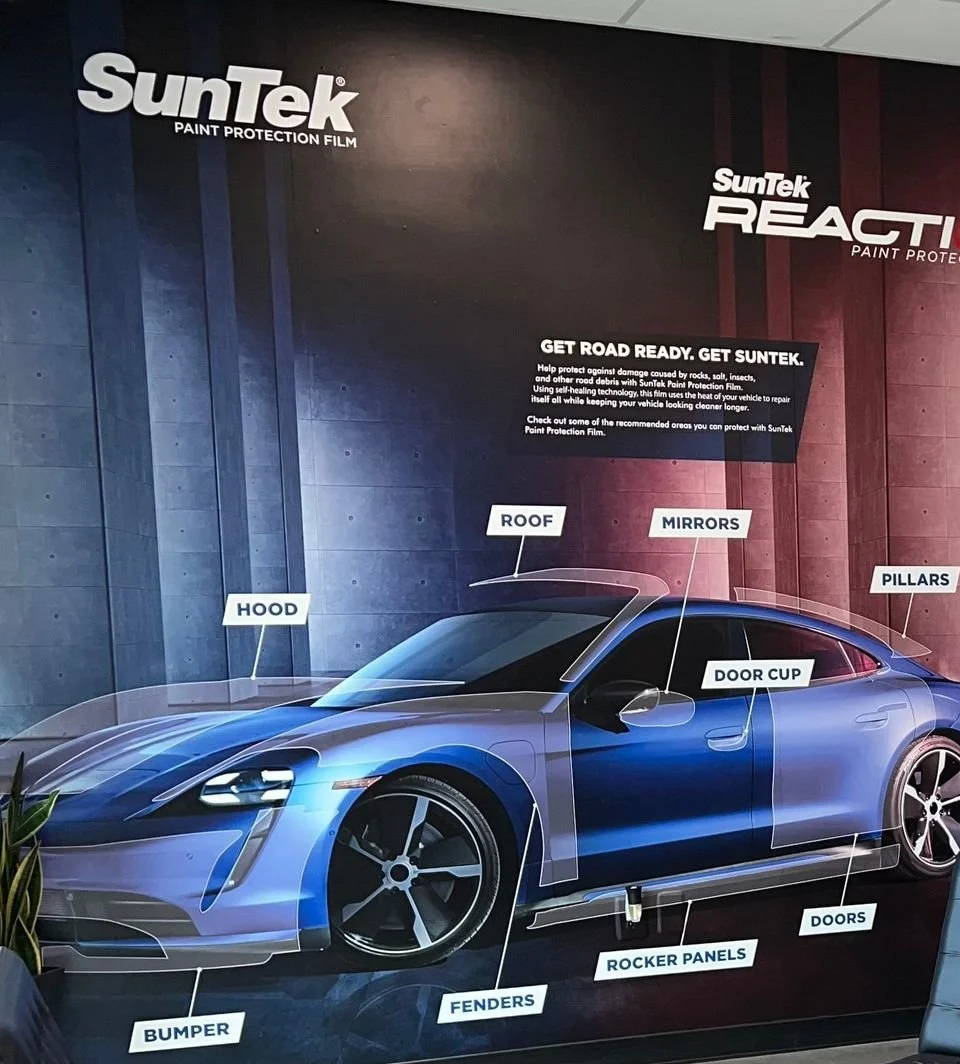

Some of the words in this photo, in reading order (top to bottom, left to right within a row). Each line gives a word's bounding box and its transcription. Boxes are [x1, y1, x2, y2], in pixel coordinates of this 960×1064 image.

[174, 122, 220, 137] PAINT
[224, 126, 320, 145] PROTECTION
[324, 134, 357, 148] FILM
[851, 245, 900, 259] PAINT
[540, 339, 576, 354] GET
[580, 341, 630, 357] ROAD
[634, 344, 694, 360] READY.
[699, 348, 731, 362] GET
[735, 350, 804, 366] SUNTEK.
[537, 364, 556, 373] Help
[559, 366, 585, 375] protect
[587, 367, 615, 375] against
[617, 368, 648, 377] damage
[650, 370, 676, 378] caused
[679, 371, 687, 380] by
[689, 372, 711, 380] rocks,
[729, 373, 756, 382] insects,
[596, 377, 619, 385] debris
[621, 378, 637, 386] with
[639, 379, 665, 387] SunTek
[688, 381, 724, 390] Protection
[726, 383, 743, 391] Film.
[533, 385, 554, 394] Using
[555, 386, 596, 396] self-healing
[598, 388, 638, 398] technology,
[654, 390, 667, 398] film
[697, 392, 713, 400] heat
[739, 393, 761, 401] vehicle
[763, 394, 770, 402] to
[771, 396, 791, 404] repair
[531, 395, 550, 403] itself
[552, 396, 561, 404] all
[563, 396, 584, 405] while
[586, 397, 617, 407] keeping
[619, 400, 636, 408] your
[638, 400, 664, 408] vehicle
[666, 401, 693, 411] looking
[695, 402, 722, 410] cleaner
[724, 403, 749, 412] longer.
[525, 426, 545, 434] Paint
[546, 427, 585, 436] Protection
[587, 428, 605, 436] Film.
[527, 415, 551, 424] Check
[554, 417, 567, 425] out
[591, 418, 600, 426] of
[601, 418, 614, 426] the
[616, 420, 669, 428] recommended
[751, 424, 766, 432] with
[501, 514, 553, 527] ROOF
[662, 517, 740, 530] MIRRORS
[882, 573, 950, 586] PILLARS
[237, 603, 298, 616] HOOD
[714, 669, 763, 681] DOOR
[768, 668, 801, 680] CUP
[811, 912, 866, 927] DOORS
[607, 954, 678, 971] ROCKER
[683, 948, 746, 965] PANELS
[450, 994, 535, 1014] FENDERS
[143, 1022, 230, 1043] BUMPER
